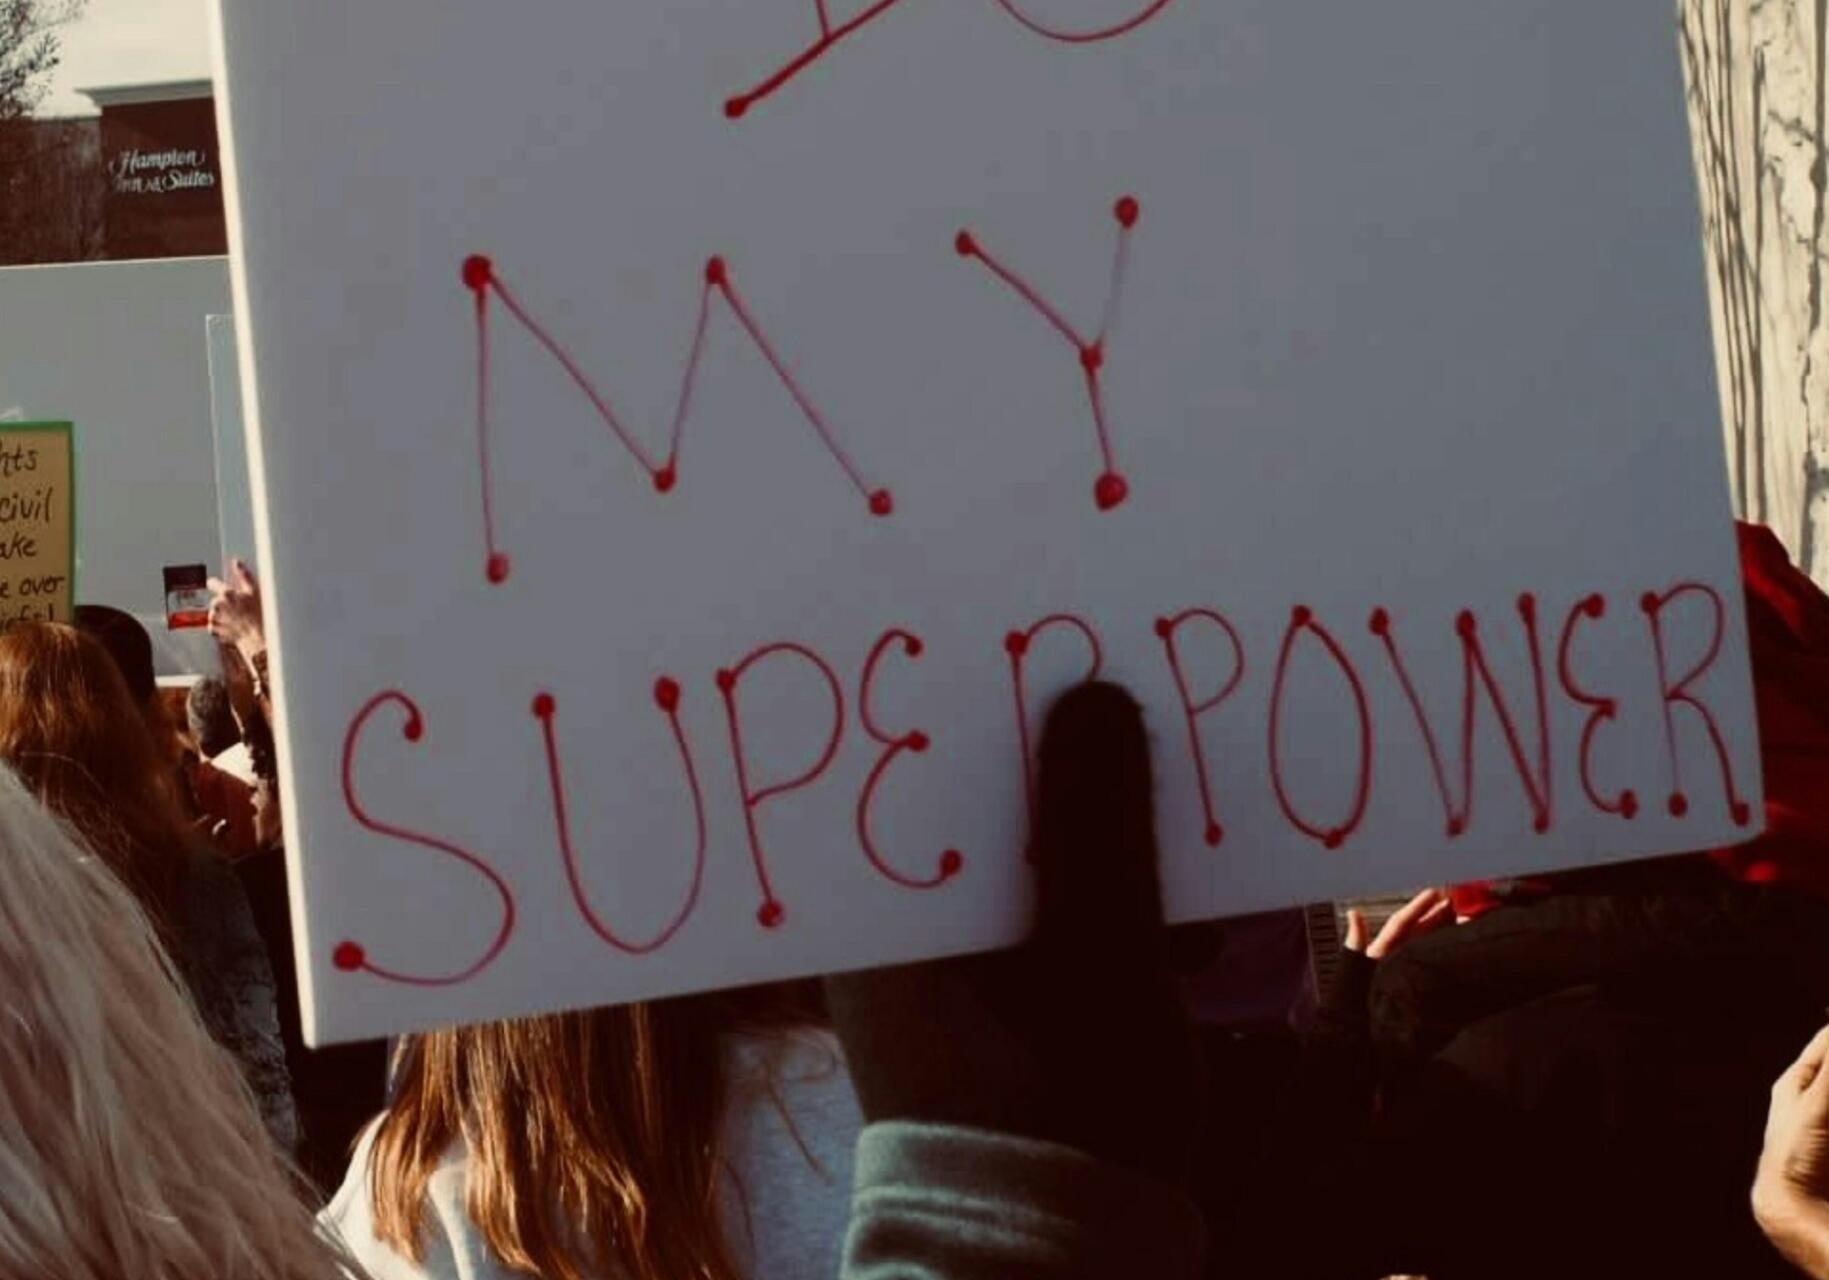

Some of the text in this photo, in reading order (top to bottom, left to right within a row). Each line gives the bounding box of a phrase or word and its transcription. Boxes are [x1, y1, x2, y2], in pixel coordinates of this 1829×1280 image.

[108, 149, 205, 177] Hampton
[162, 169, 214, 191] Suites
[460, 195, 1141, 587] MY
[0, 486, 53, 523] civil
[19, 576, 64, 596] over
